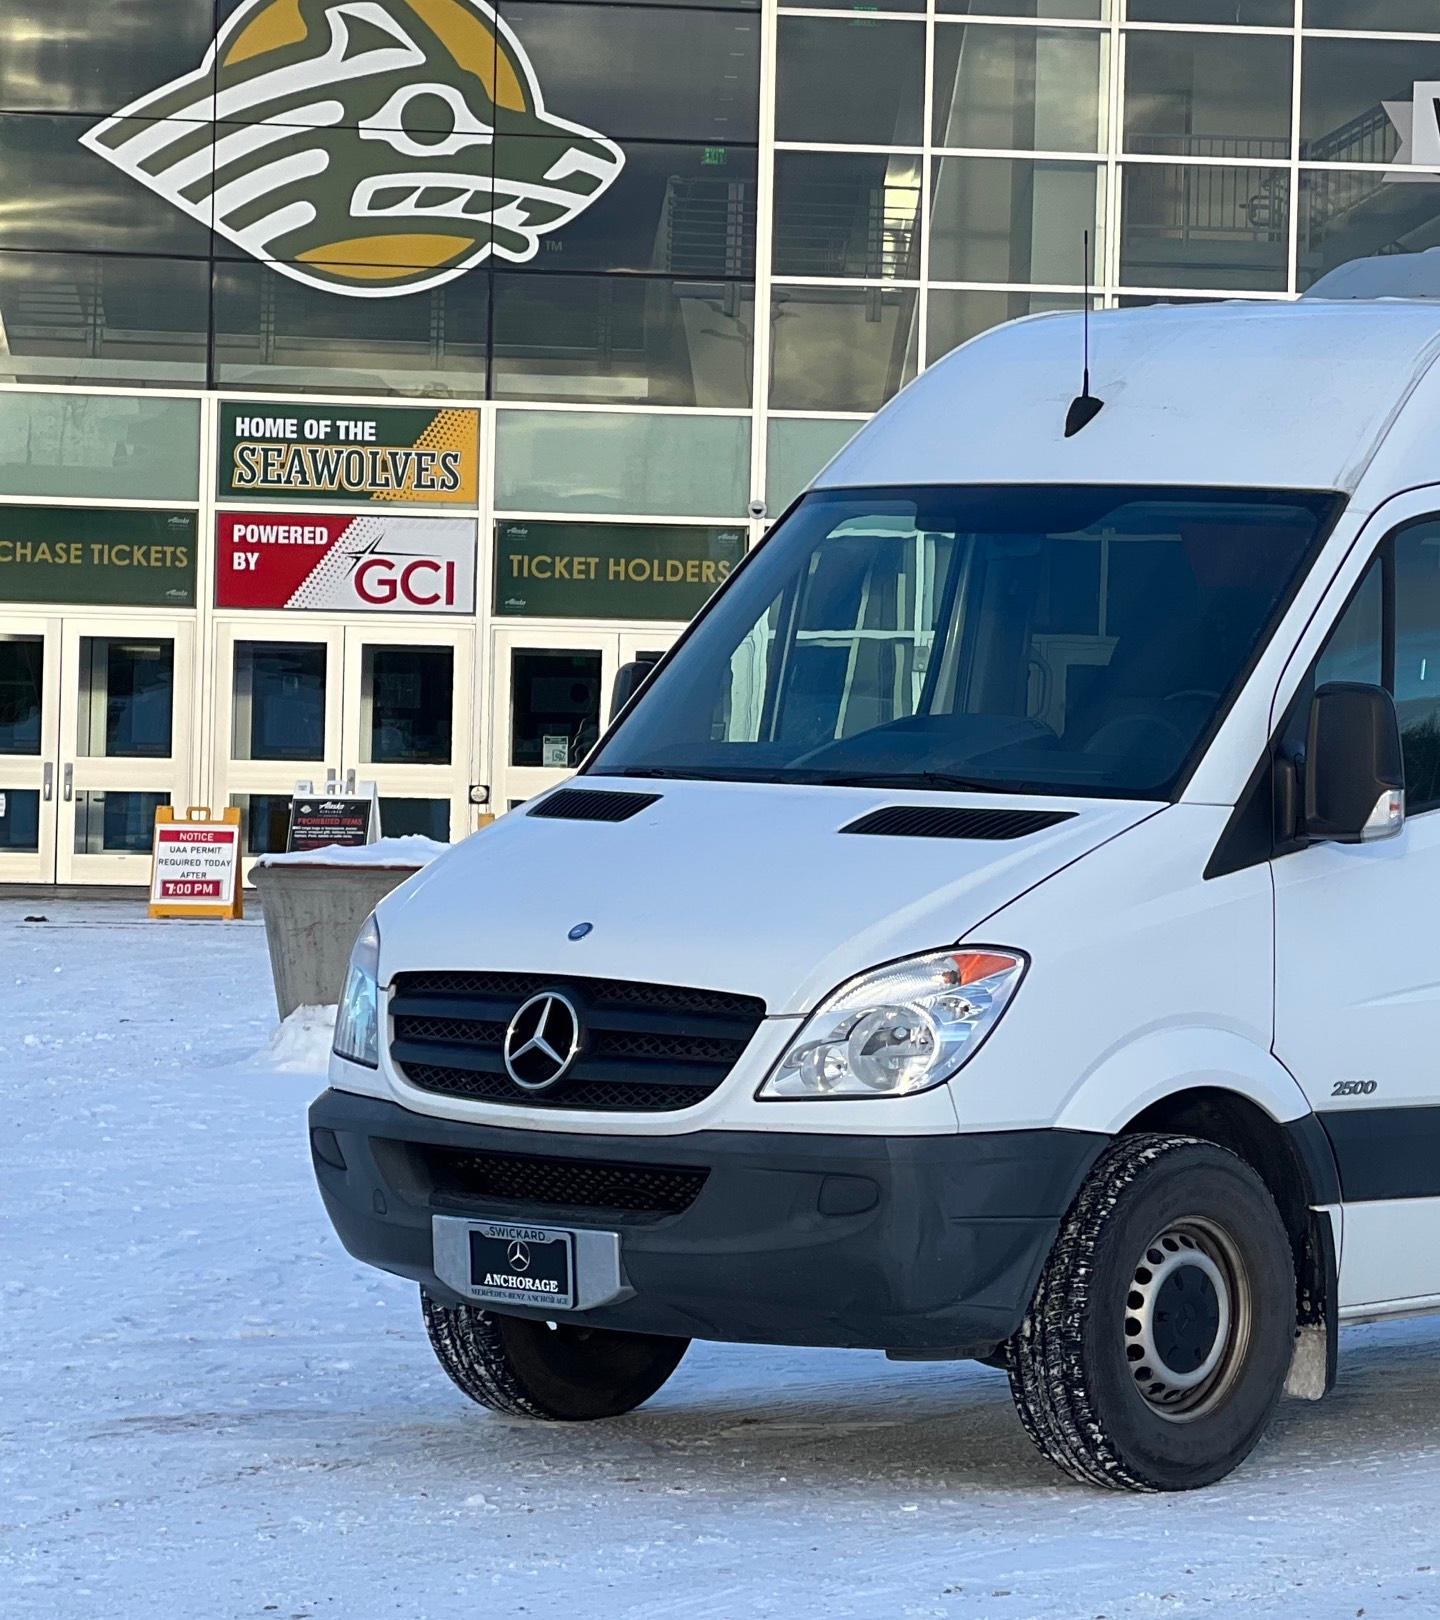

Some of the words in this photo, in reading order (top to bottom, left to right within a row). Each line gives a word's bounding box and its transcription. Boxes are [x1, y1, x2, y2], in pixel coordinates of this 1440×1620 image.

[235, 417, 297, 439] HOME
[304, 419, 331, 440] OF
[337, 420, 376, 441] THE
[232, 442, 461, 492] SEAWOLVES
[233, 524, 329, 545] POWERED
[0, 541, 82, 564] CHASE
[90, 544, 188, 568] TICKETS
[233, 552, 259, 571] BY
[509, 555, 599, 580] TICKET
[608, 558, 730, 583] HOLDERS
[354, 558, 455, 606] GCI
[179, 832, 214, 842] NOTICE
[169, 846, 187, 854] UAA
[190, 846, 222, 855] PERMIT
[158, 858, 201, 867] REQUIRED
[204, 859, 232, 868] TODAY
[180, 871, 207, 879] AFTER
[165, 883, 191, 895] 7:00
[194, 883, 213, 894] PM
[1331, 1080, 1377, 1097] 2500
[489, 1226, 546, 1242] SWICKARD
[484, 1273, 559, 1293] ANCHORAGE
